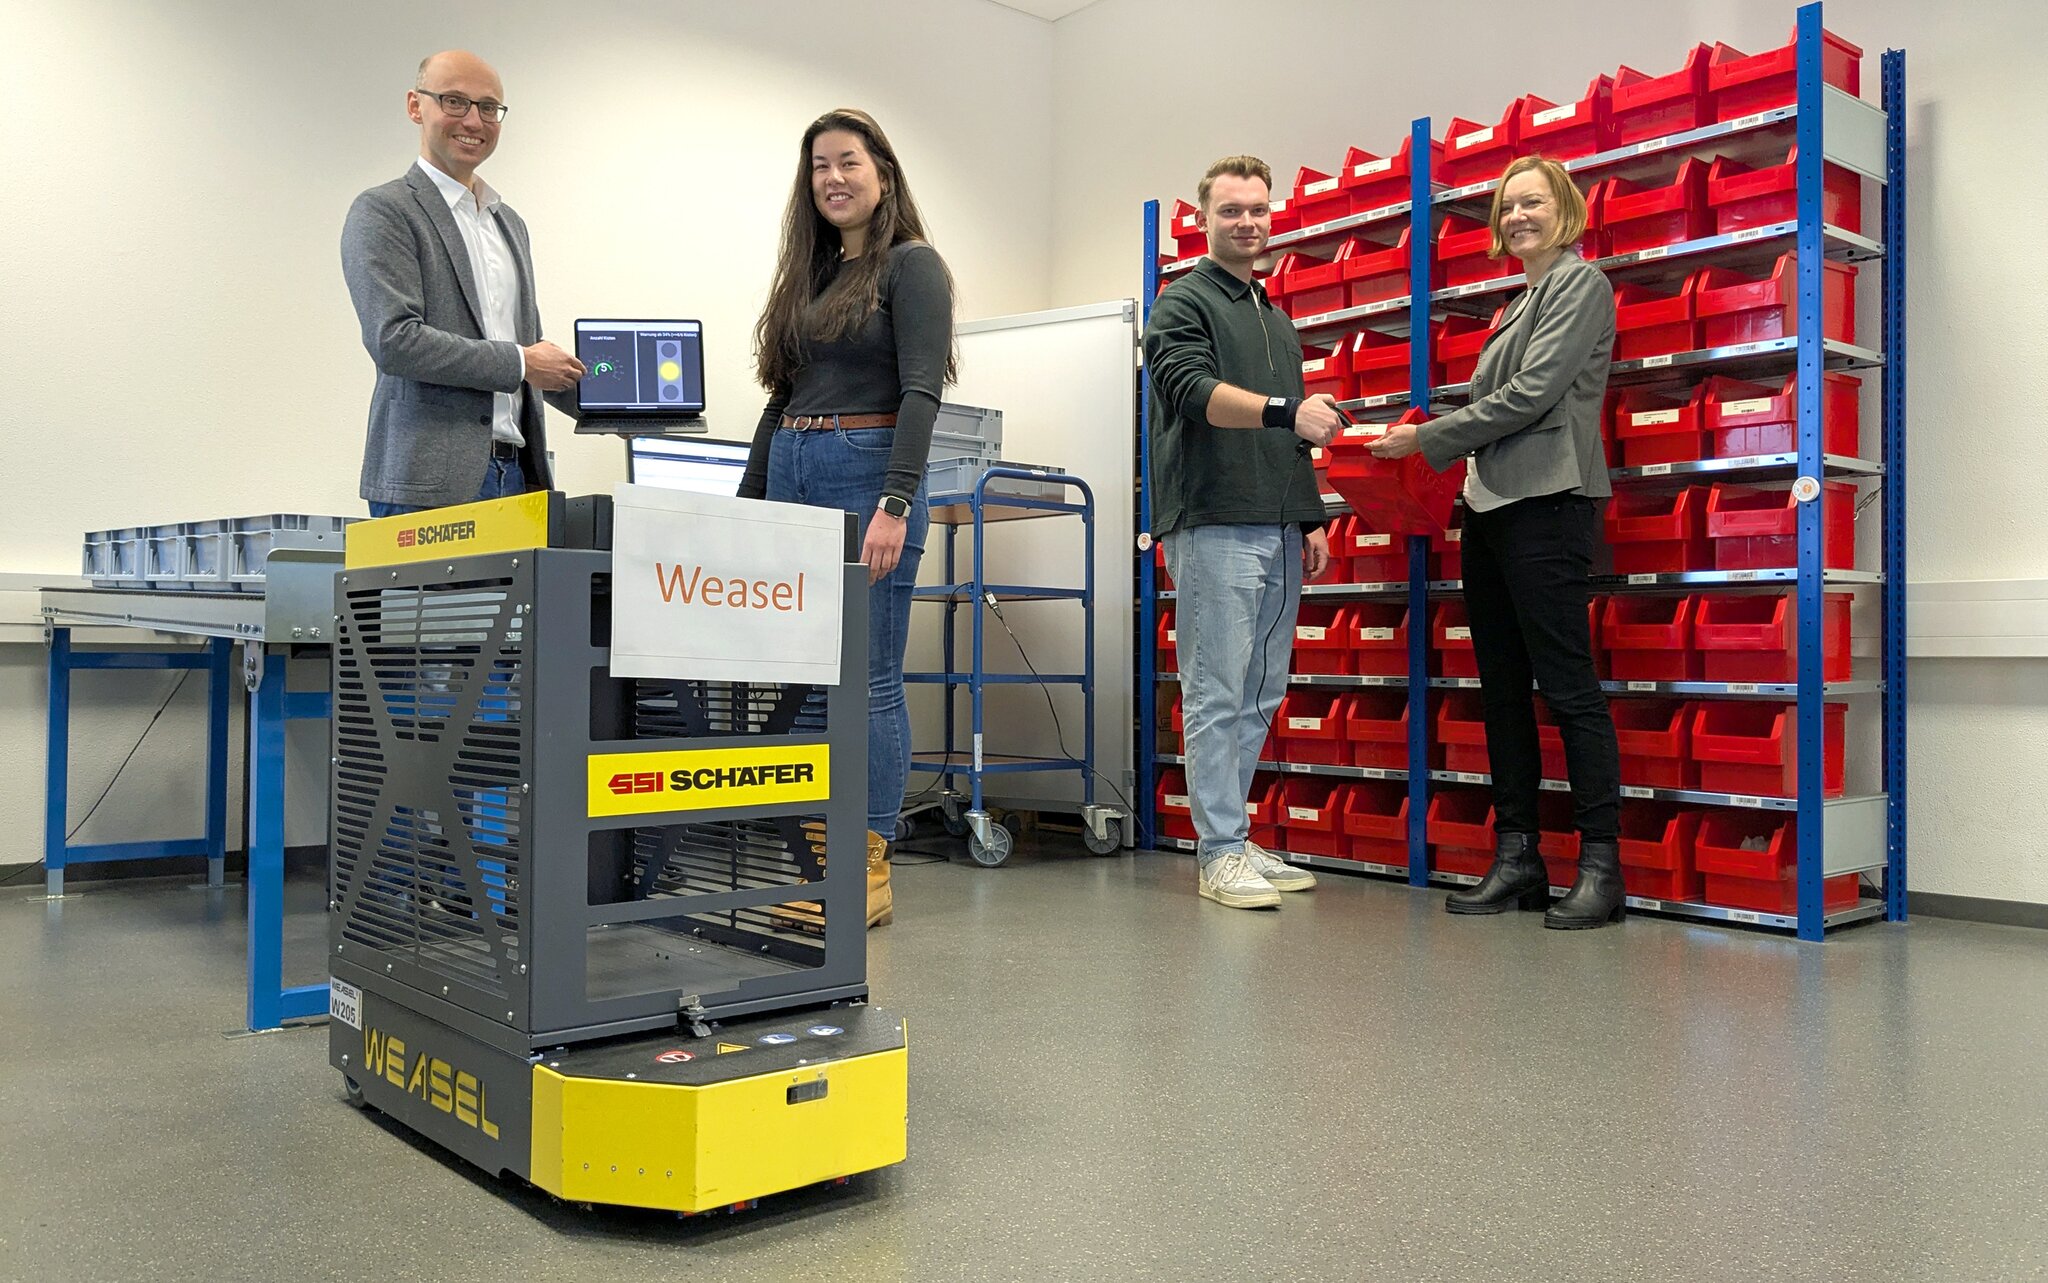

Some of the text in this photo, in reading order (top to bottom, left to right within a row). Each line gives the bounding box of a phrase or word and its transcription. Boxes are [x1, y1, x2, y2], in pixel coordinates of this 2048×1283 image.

[600, 363, 608, 373] 5
[397, 520, 476, 548] SSI SCHÄFER
[655, 562, 804, 612] Weasel
[607, 763, 814, 795] SSI SCHÄFER
[331, 996, 356, 1024] W205
[364, 1023, 499, 1141] WEASEL
